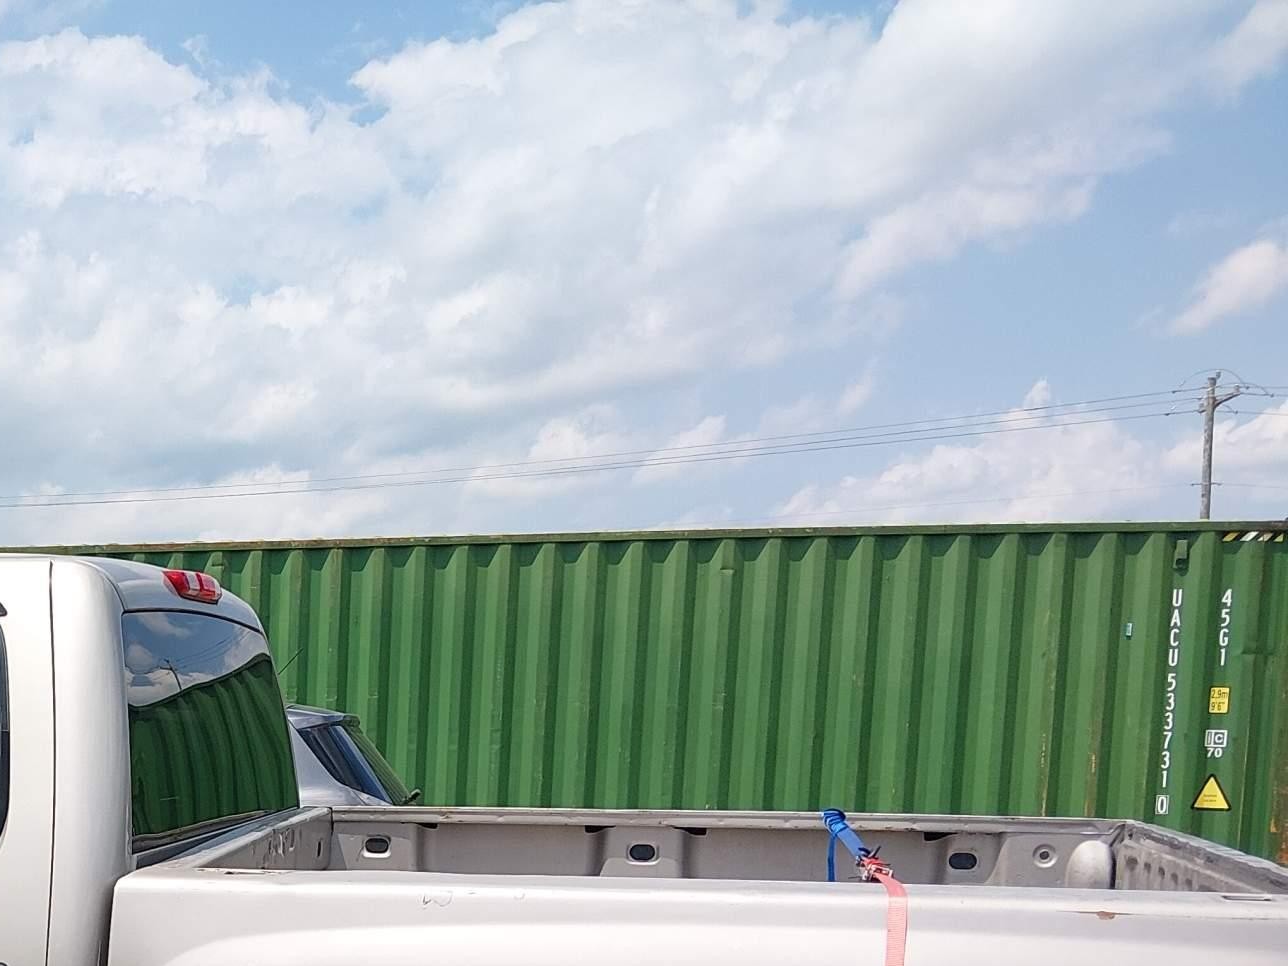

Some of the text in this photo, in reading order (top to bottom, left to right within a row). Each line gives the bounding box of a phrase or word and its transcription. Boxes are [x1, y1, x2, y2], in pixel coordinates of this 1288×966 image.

[1167, 588, 1183, 667] UACU
[1218, 588, 1232, 666] 45G1
[1211, 689, 1229, 699] 2.9m
